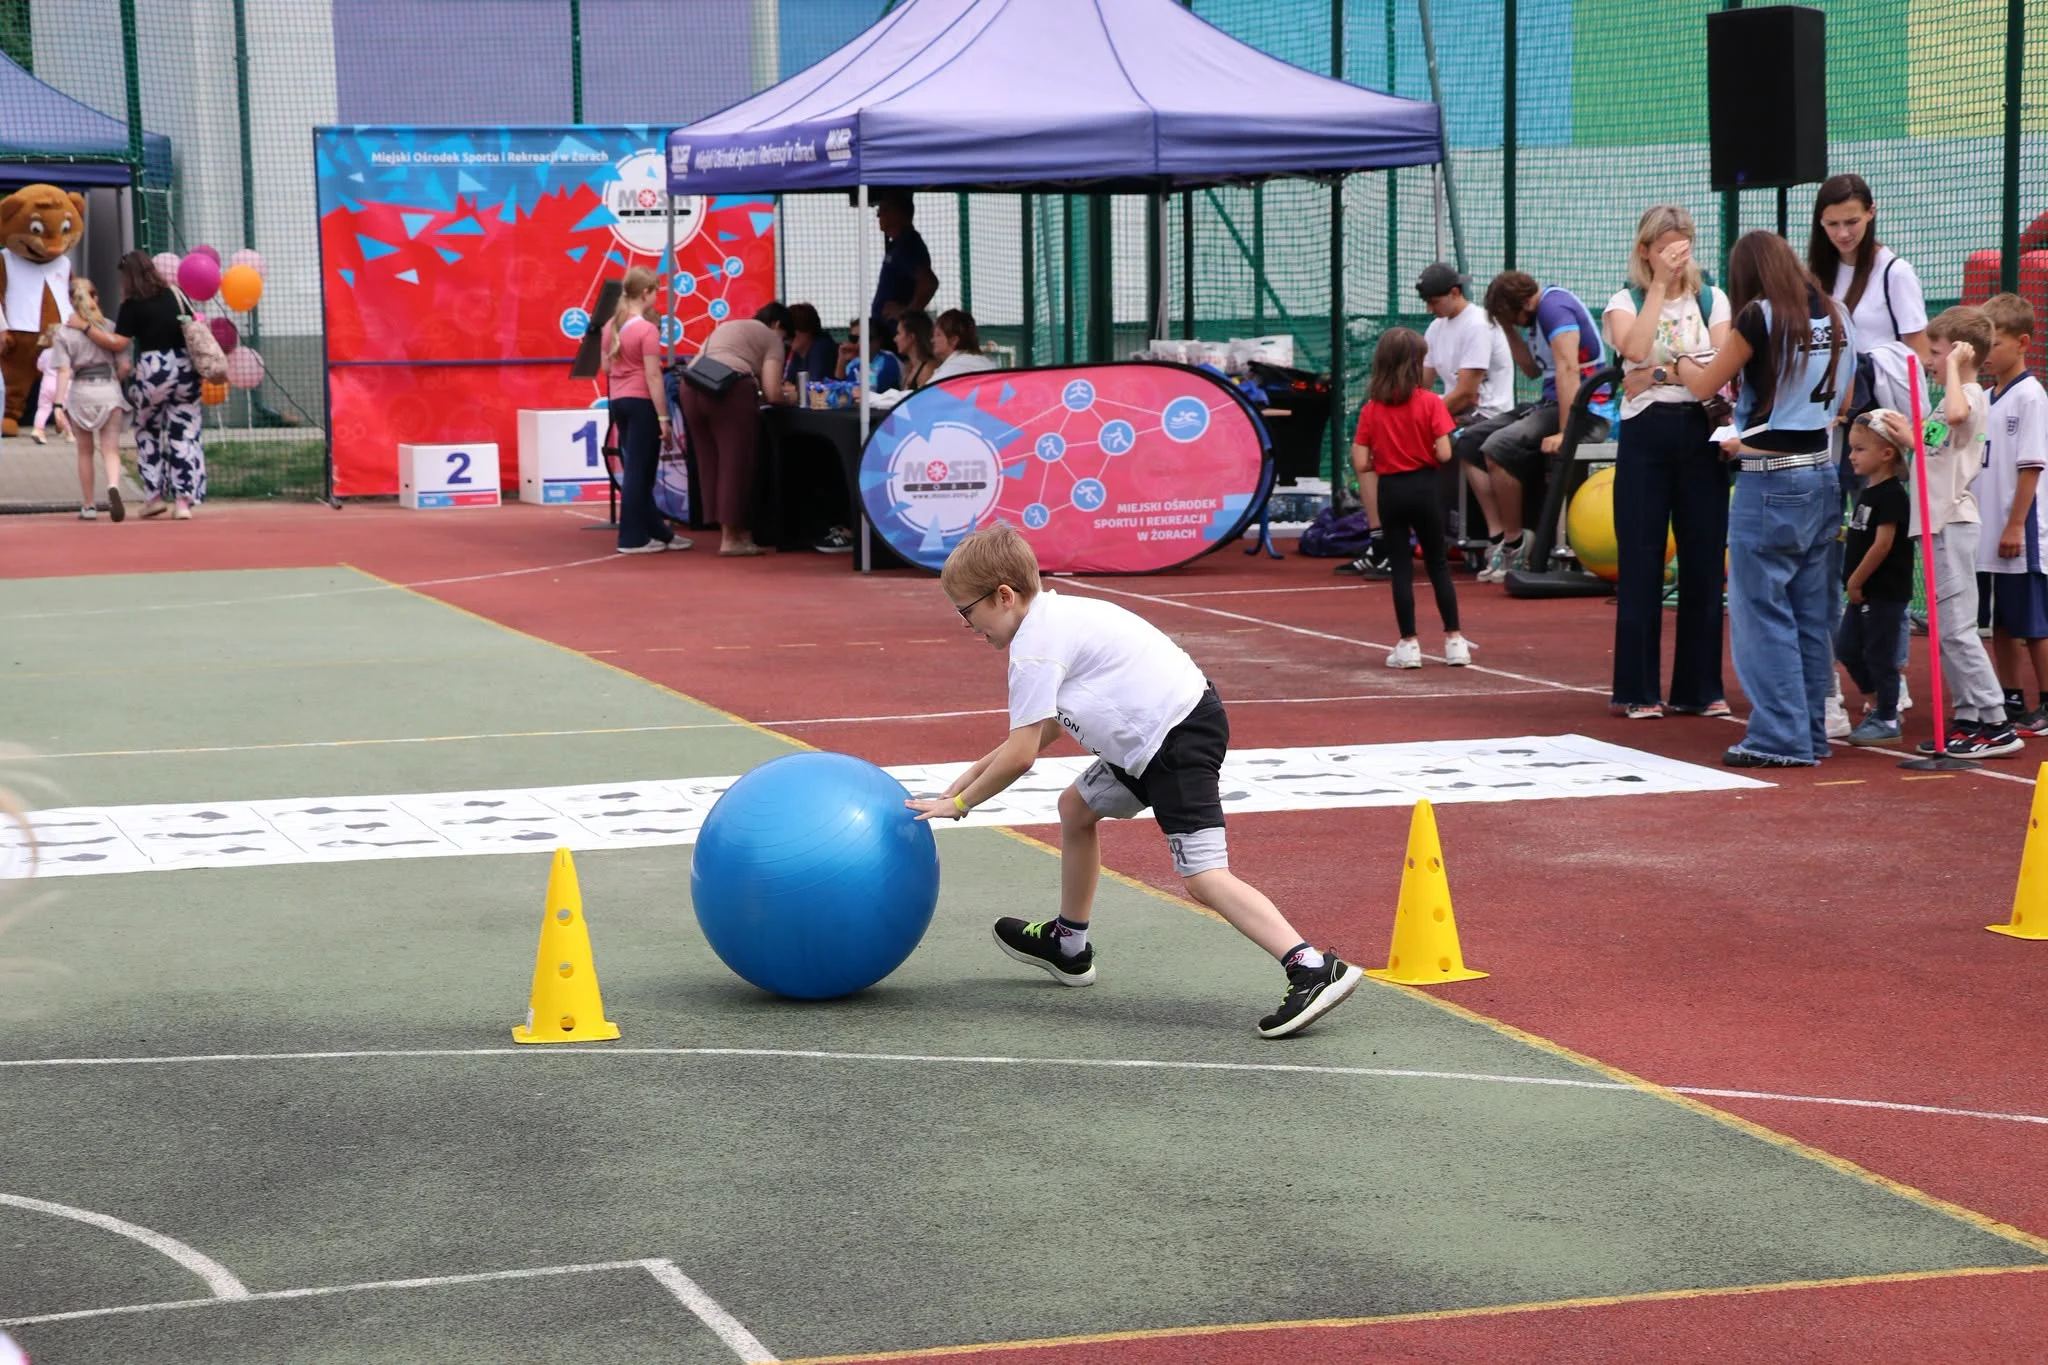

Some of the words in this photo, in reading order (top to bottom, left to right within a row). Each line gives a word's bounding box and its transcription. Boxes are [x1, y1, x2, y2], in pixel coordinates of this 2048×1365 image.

[371, 151, 411, 165] Miejski
[462, 151, 499, 165] Sportu
[508, 151, 557, 165] Rekreacji
[560, 153, 570, 162] w
[572, 420, 599, 467] 1
[446, 452, 472, 485] 2
[1117, 502, 1162, 514] MIEJSKI
[1163, 498, 1217, 512] OŚRODEK
[1094, 517, 1138, 529] SPORTU
[1140, 517, 1144, 527] I
[1147, 513, 1207, 527] REKREACJI
[1136, 531, 1149, 541] W
[1150, 528, 1197, 541] ŻORACH
[1055, 711, 1080, 733] TON
